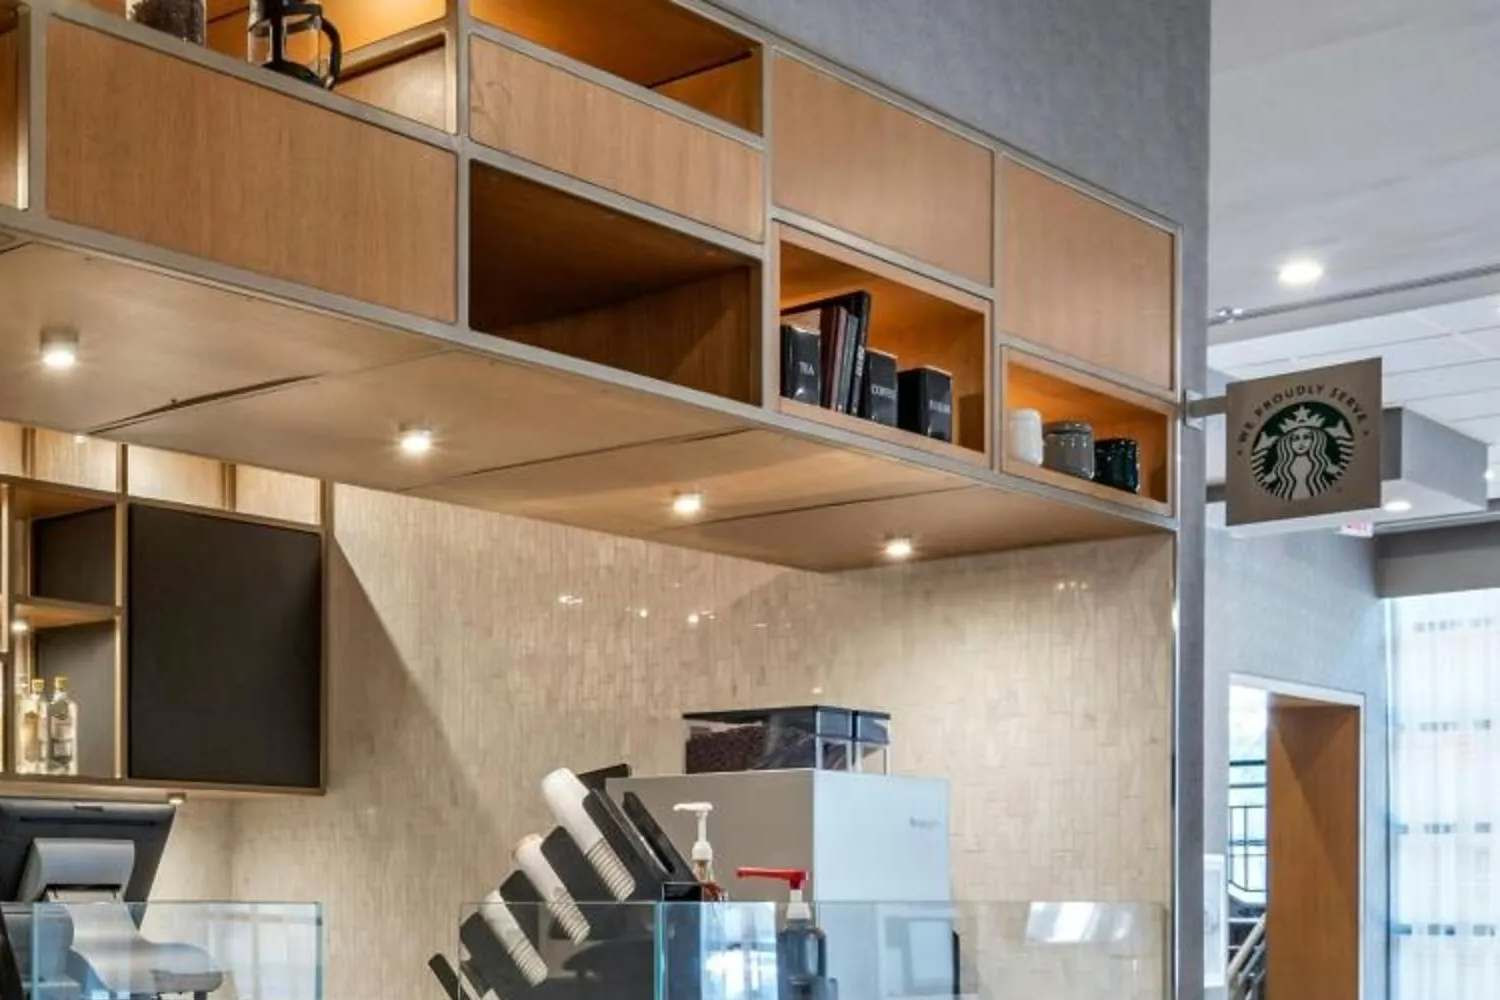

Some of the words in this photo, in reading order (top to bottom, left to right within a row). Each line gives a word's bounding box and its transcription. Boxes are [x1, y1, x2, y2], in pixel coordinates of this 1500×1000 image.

[1238, 421, 1255, 445] WE
[1255, 384, 1325, 418] PROUDLY
[1329, 387, 1369, 423] SERVE
